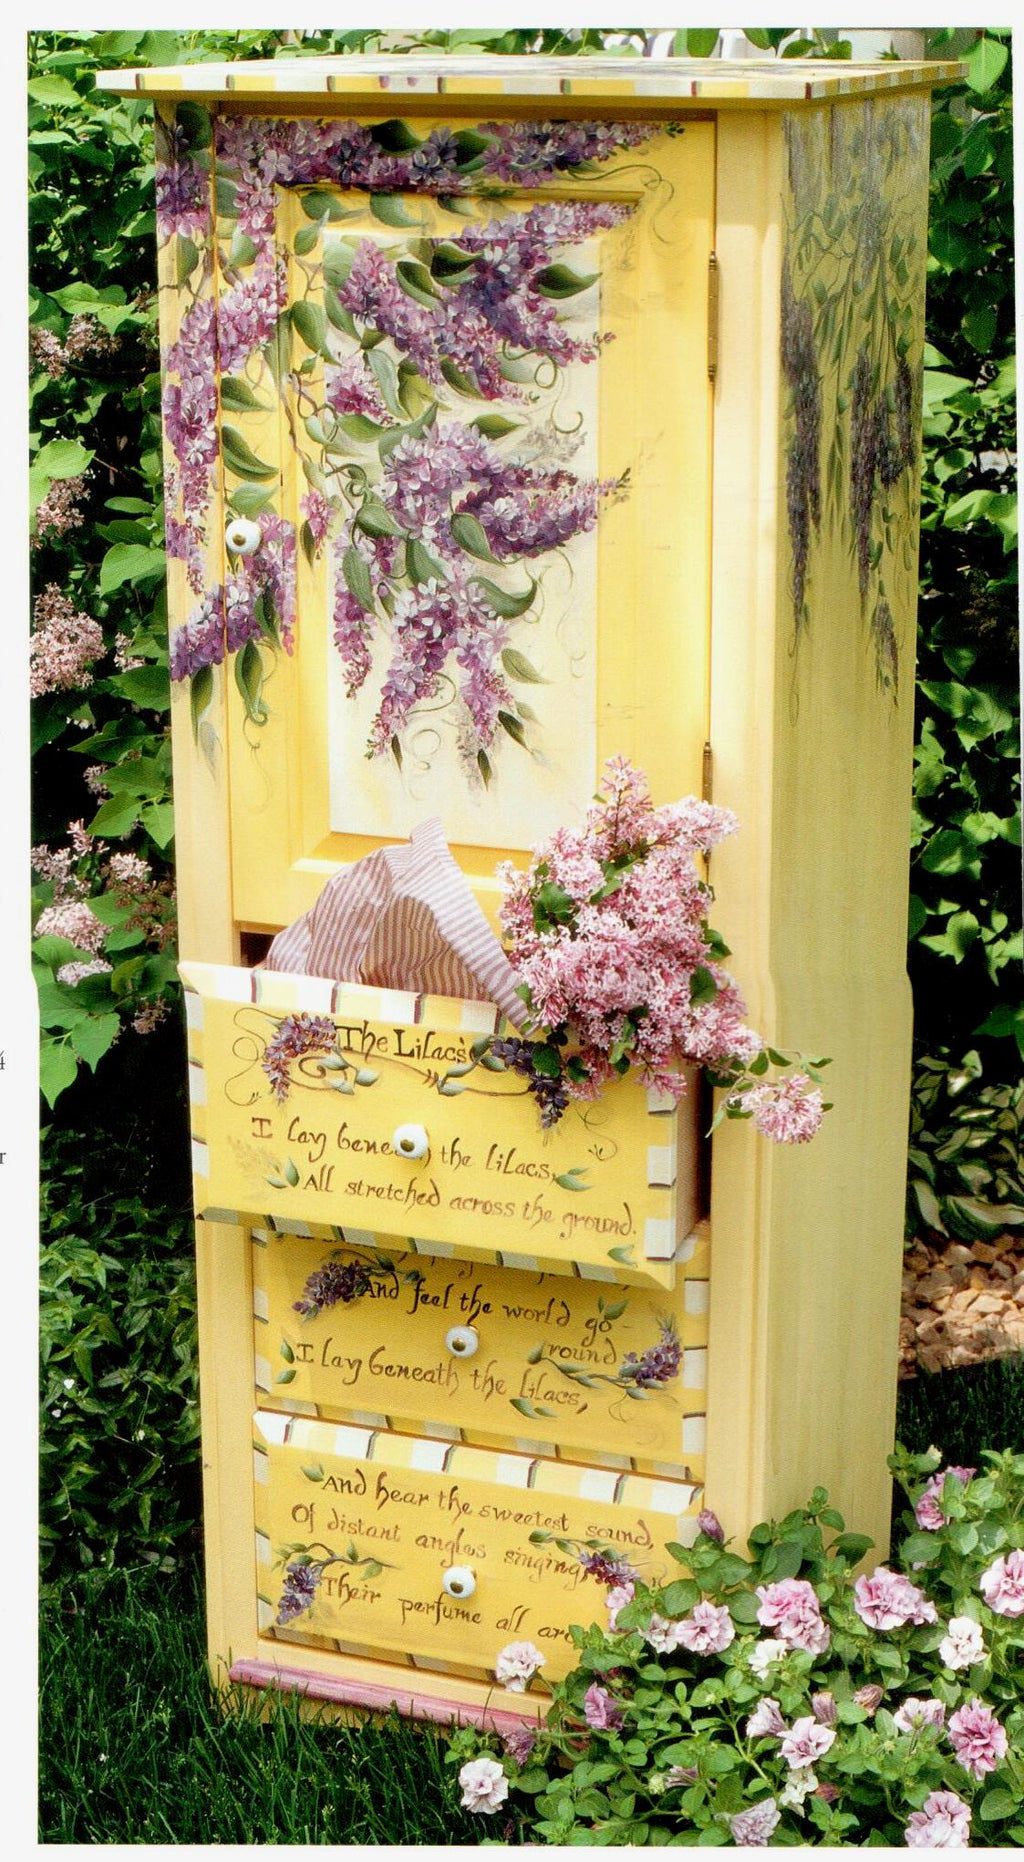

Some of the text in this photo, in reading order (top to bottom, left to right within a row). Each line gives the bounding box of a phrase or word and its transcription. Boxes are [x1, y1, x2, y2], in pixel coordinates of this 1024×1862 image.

[334, 1020, 388, 1063] The
[251, 1117, 273, 1139] I
[287, 1116, 326, 1163] lay
[337, 1121, 432, 1169] bene
[439, 1137, 472, 1171] the
[302, 1163, 637, 1240] All stretched across the ground.
[362, 1272, 400, 1299] And
[406, 1278, 454, 1314] feel
[460, 1283, 493, 1325] the
[503, 1298, 571, 1327] world
[295, 1343, 314, 1362] I
[321, 1337, 363, 1385] lay
[369, 1345, 460, 1397] beneath
[469, 1359, 507, 1401] the
[546, 1337, 617, 1365] round
[291, 1502, 315, 1533] Of
[327, 1508, 400, 1542] distant
[322, 1468, 654, 1550] And hear the sweetest sound,
[321, 1572, 381, 1609] Their
[398, 1591, 482, 1626] perfume
[496, 1604, 531, 1633] all
